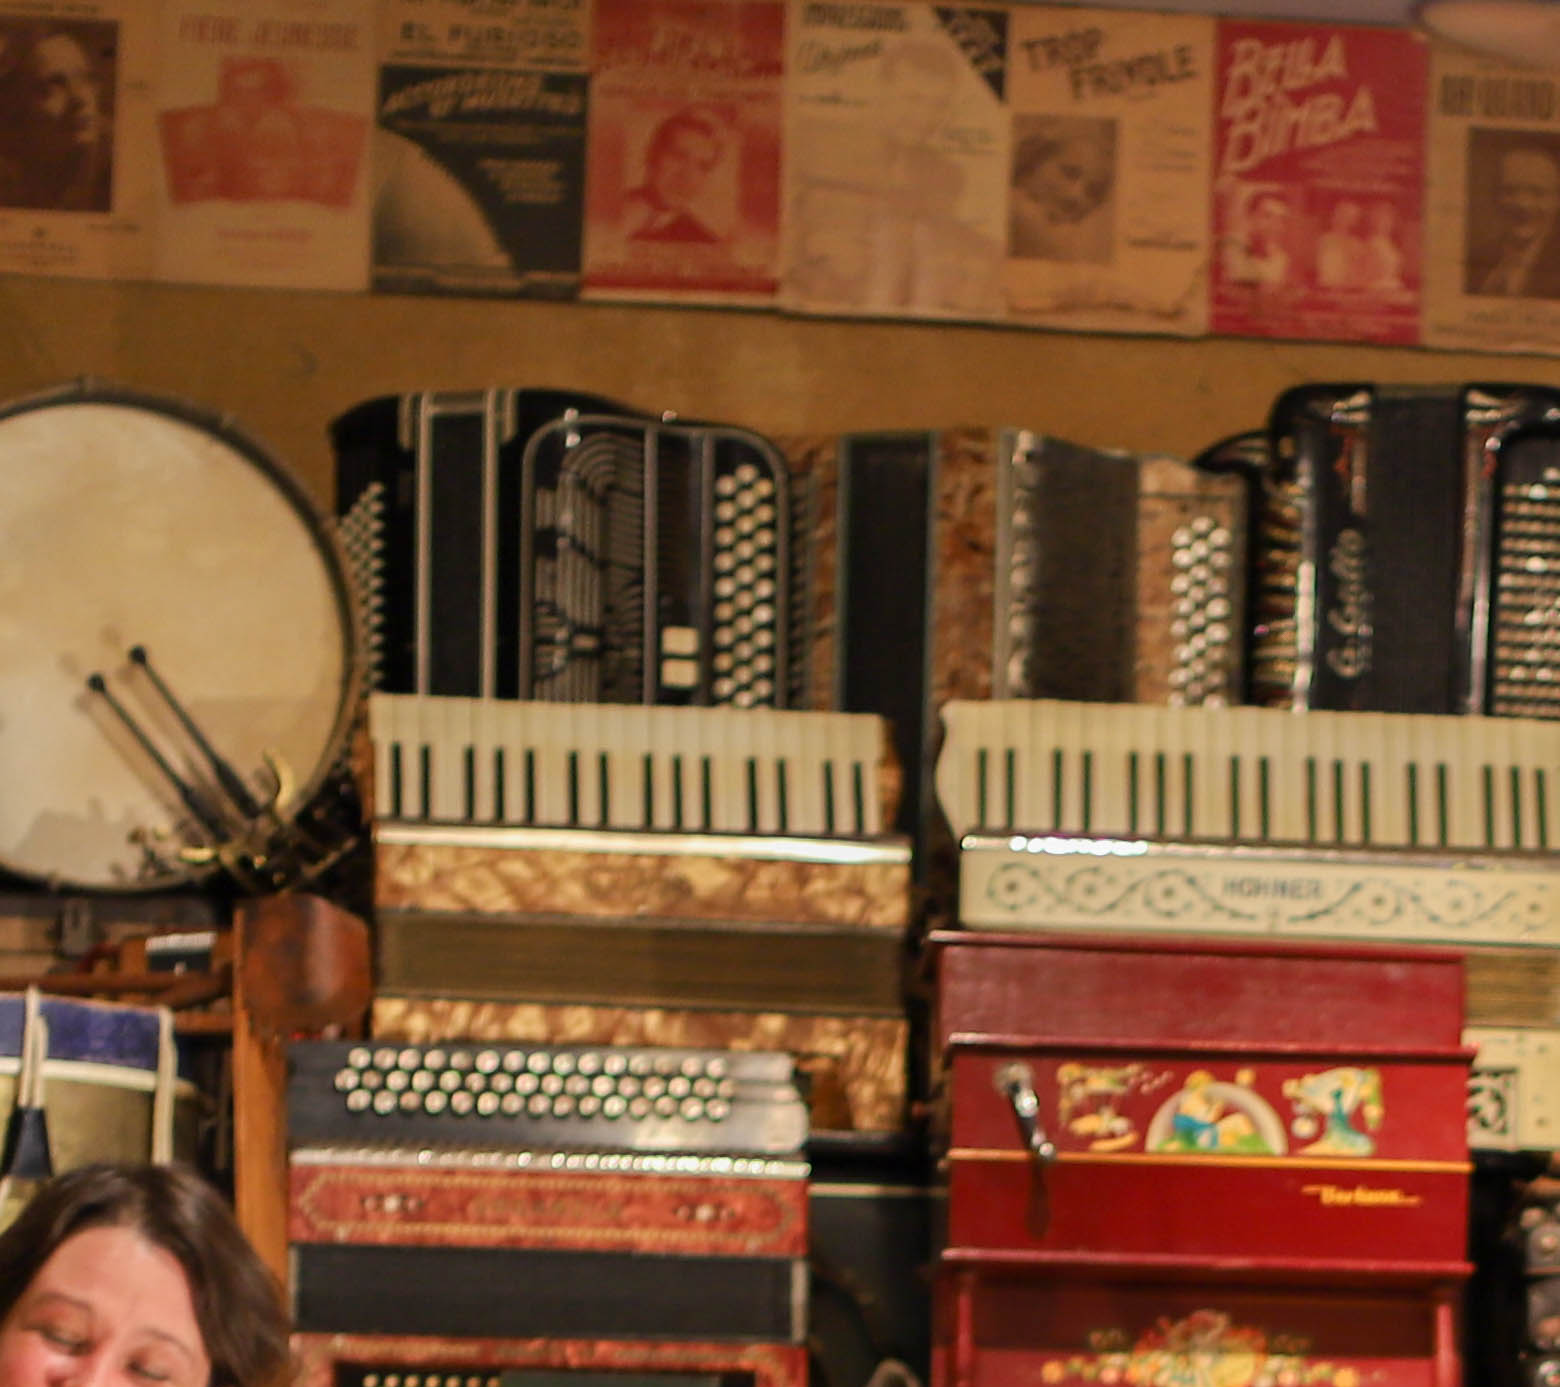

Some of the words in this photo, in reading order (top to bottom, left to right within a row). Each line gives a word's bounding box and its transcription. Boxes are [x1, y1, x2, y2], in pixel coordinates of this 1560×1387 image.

[1221, 33, 1350, 119] BELLA
[1225, 84, 1379, 174] BIMBA
[1224, 877, 1321, 899] HOHNER
